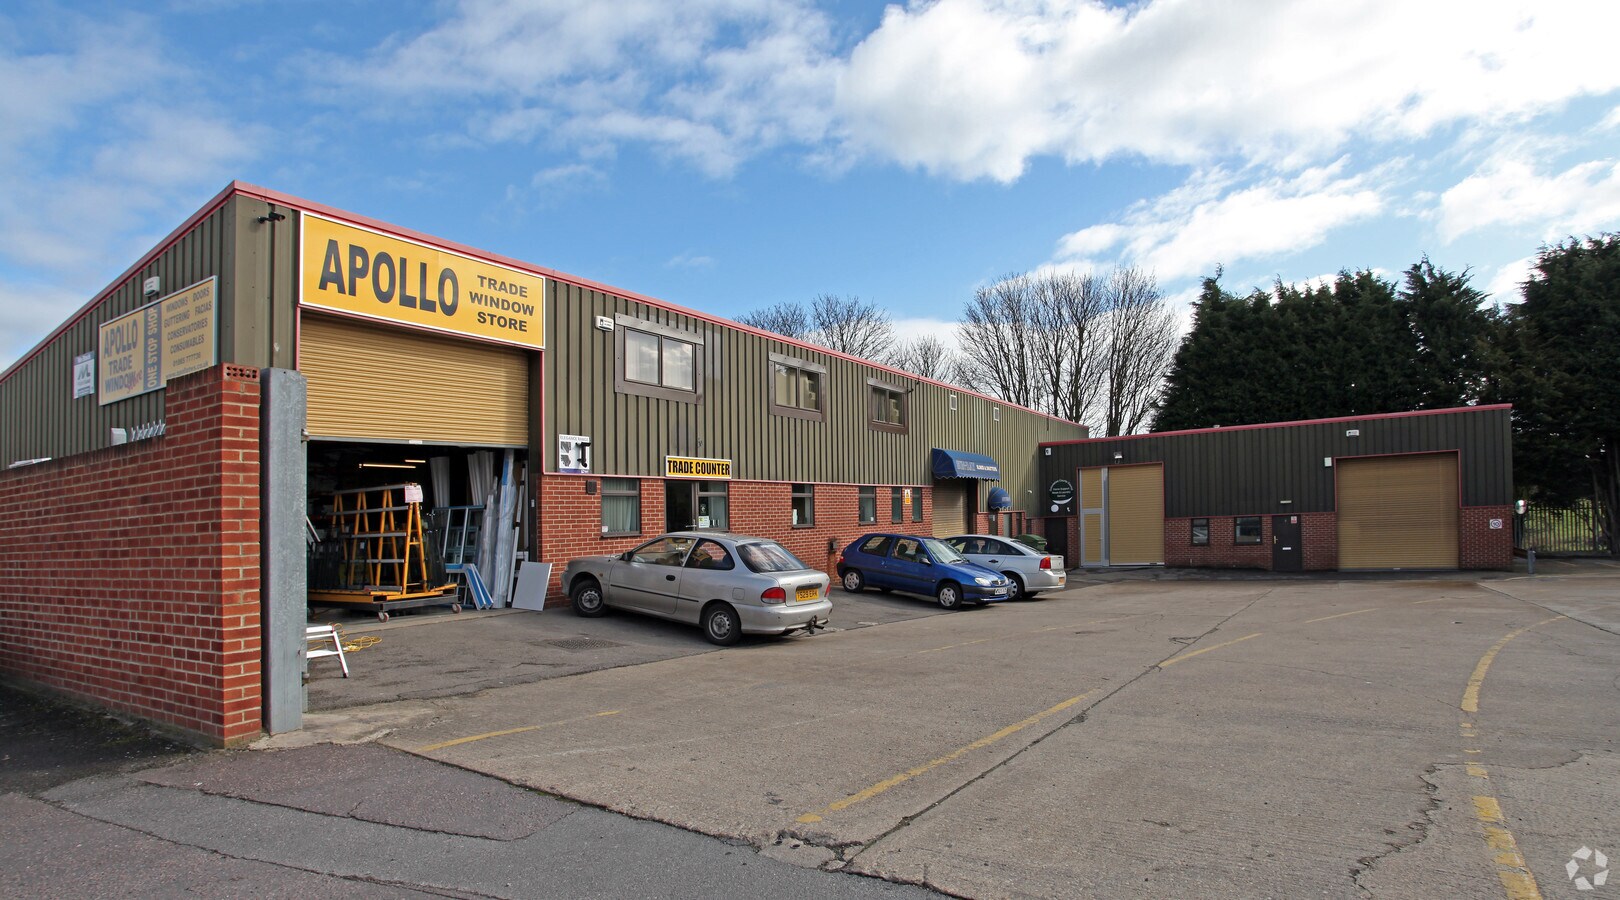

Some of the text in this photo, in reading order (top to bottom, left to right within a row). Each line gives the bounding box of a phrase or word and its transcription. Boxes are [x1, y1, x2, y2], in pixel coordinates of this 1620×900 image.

[318, 238, 459, 317] APOLLO
[477, 275, 528, 298] TRADE
[165, 287, 210, 313] WINDOWS DOORS
[469, 291, 535, 317] WINDOW
[164, 301, 212, 328] GUTTERING FACIAS
[477, 312, 528, 332] STORE
[103, 319, 138, 359] APOLLO
[167, 317, 208, 341] CONSERVATORIES
[147, 307, 158, 388] ONE STOP SHOP
[170, 334, 205, 355] CONSUMABLES
[108, 355, 133, 376] TRADE
[667, 460, 730, 475] TRADE COUNTER
